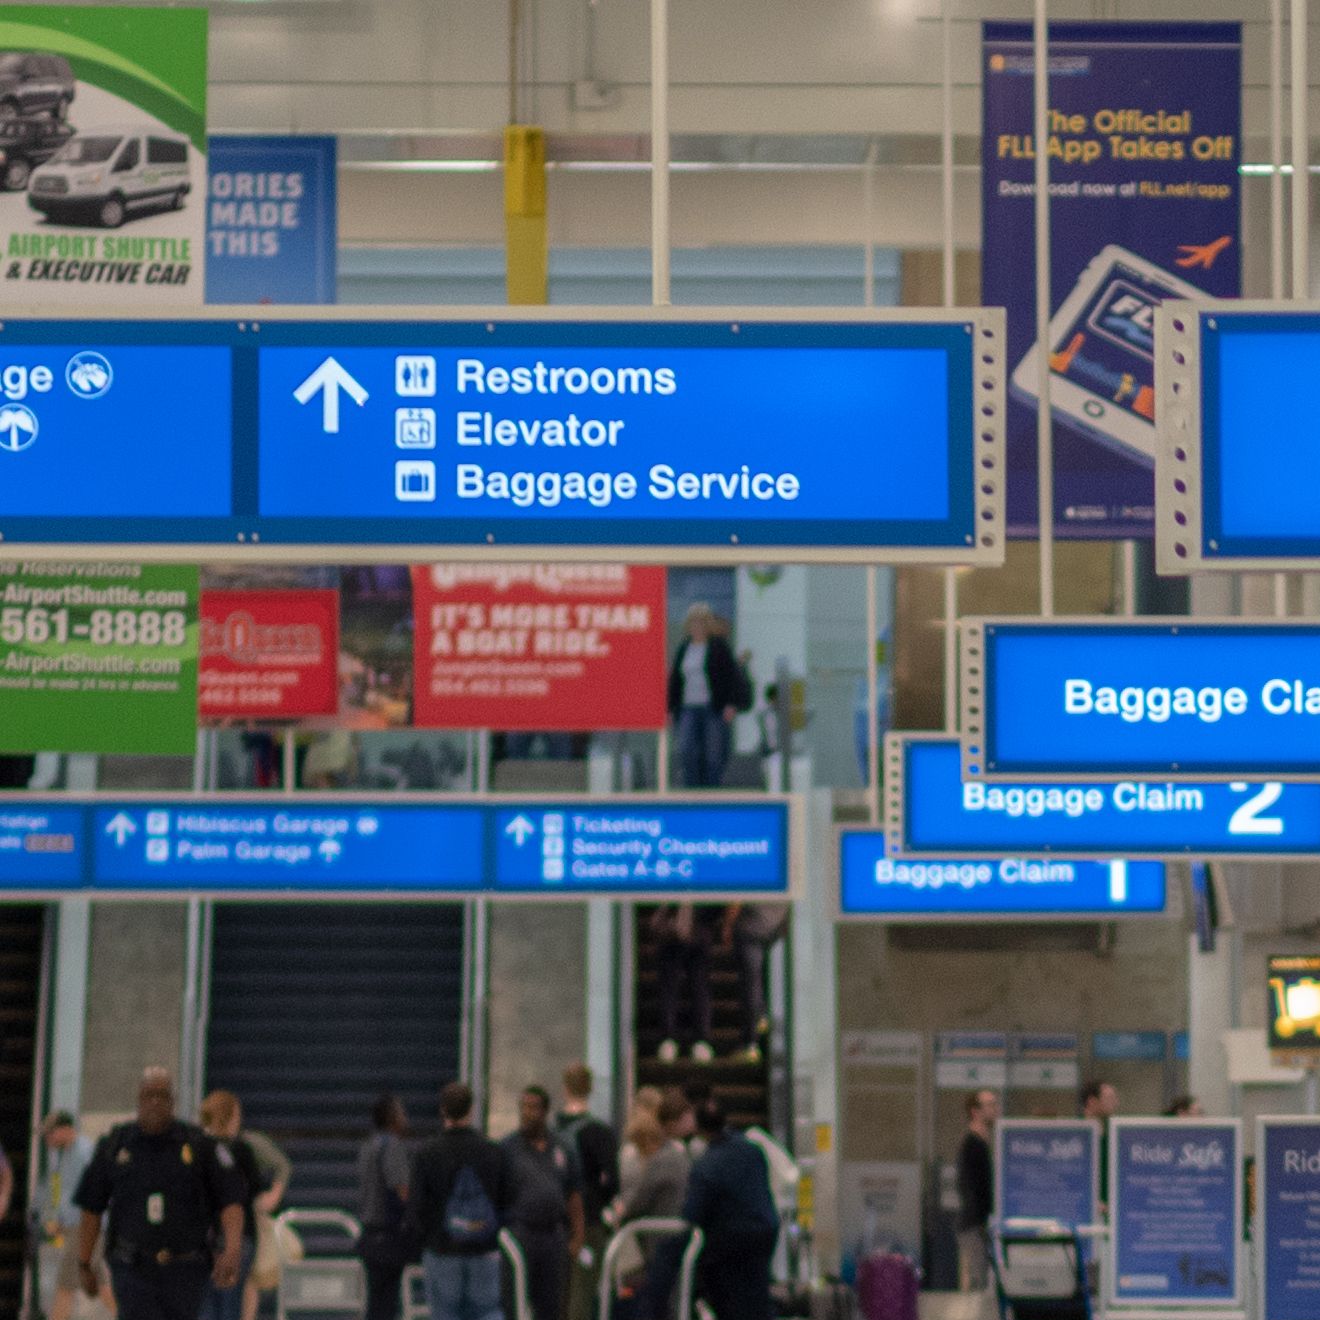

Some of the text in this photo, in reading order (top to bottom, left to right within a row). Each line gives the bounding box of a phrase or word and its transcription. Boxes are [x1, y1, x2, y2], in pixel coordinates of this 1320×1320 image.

[1094, 109, 1191, 135] Official
[998, 135, 1233, 163] FLL App Takes Off
[213, 172, 304, 199] ORIES
[1083, 182, 1116, 197] now
[1119, 181, 1136, 197] at
[211, 202, 298, 228] MADE
[8, 233, 191, 261] AIRPORT SHUTTLE
[210, 231, 279, 257] THIS
[6, 259, 191, 286] & EXECUTIVE CAR
[457, 359, 677, 395] Restrooms
[457, 413, 624, 447] Elevator
[457, 465, 800, 507] Baggage Service
[1, 607, 187, 646] 561-8888
[575, 606, 649, 632] THAN
[431, 630, 451, 656] A
[1064, 679, 1248, 721] Baggage
[962, 783, 1284, 834] Baggage Claim 2
[176, 814, 349, 837] Hibiscus Garage
[573, 815, 661, 837] Ticketing
[177, 840, 312, 865] Palm Garage
[572, 838, 768, 858] Security Checkpoint
[572, 859, 694, 878] Gates A-B-C
[875, 859, 1128, 901] Baggage Claim 1
[1130, 1140, 1224, 1170] Ride Safe
